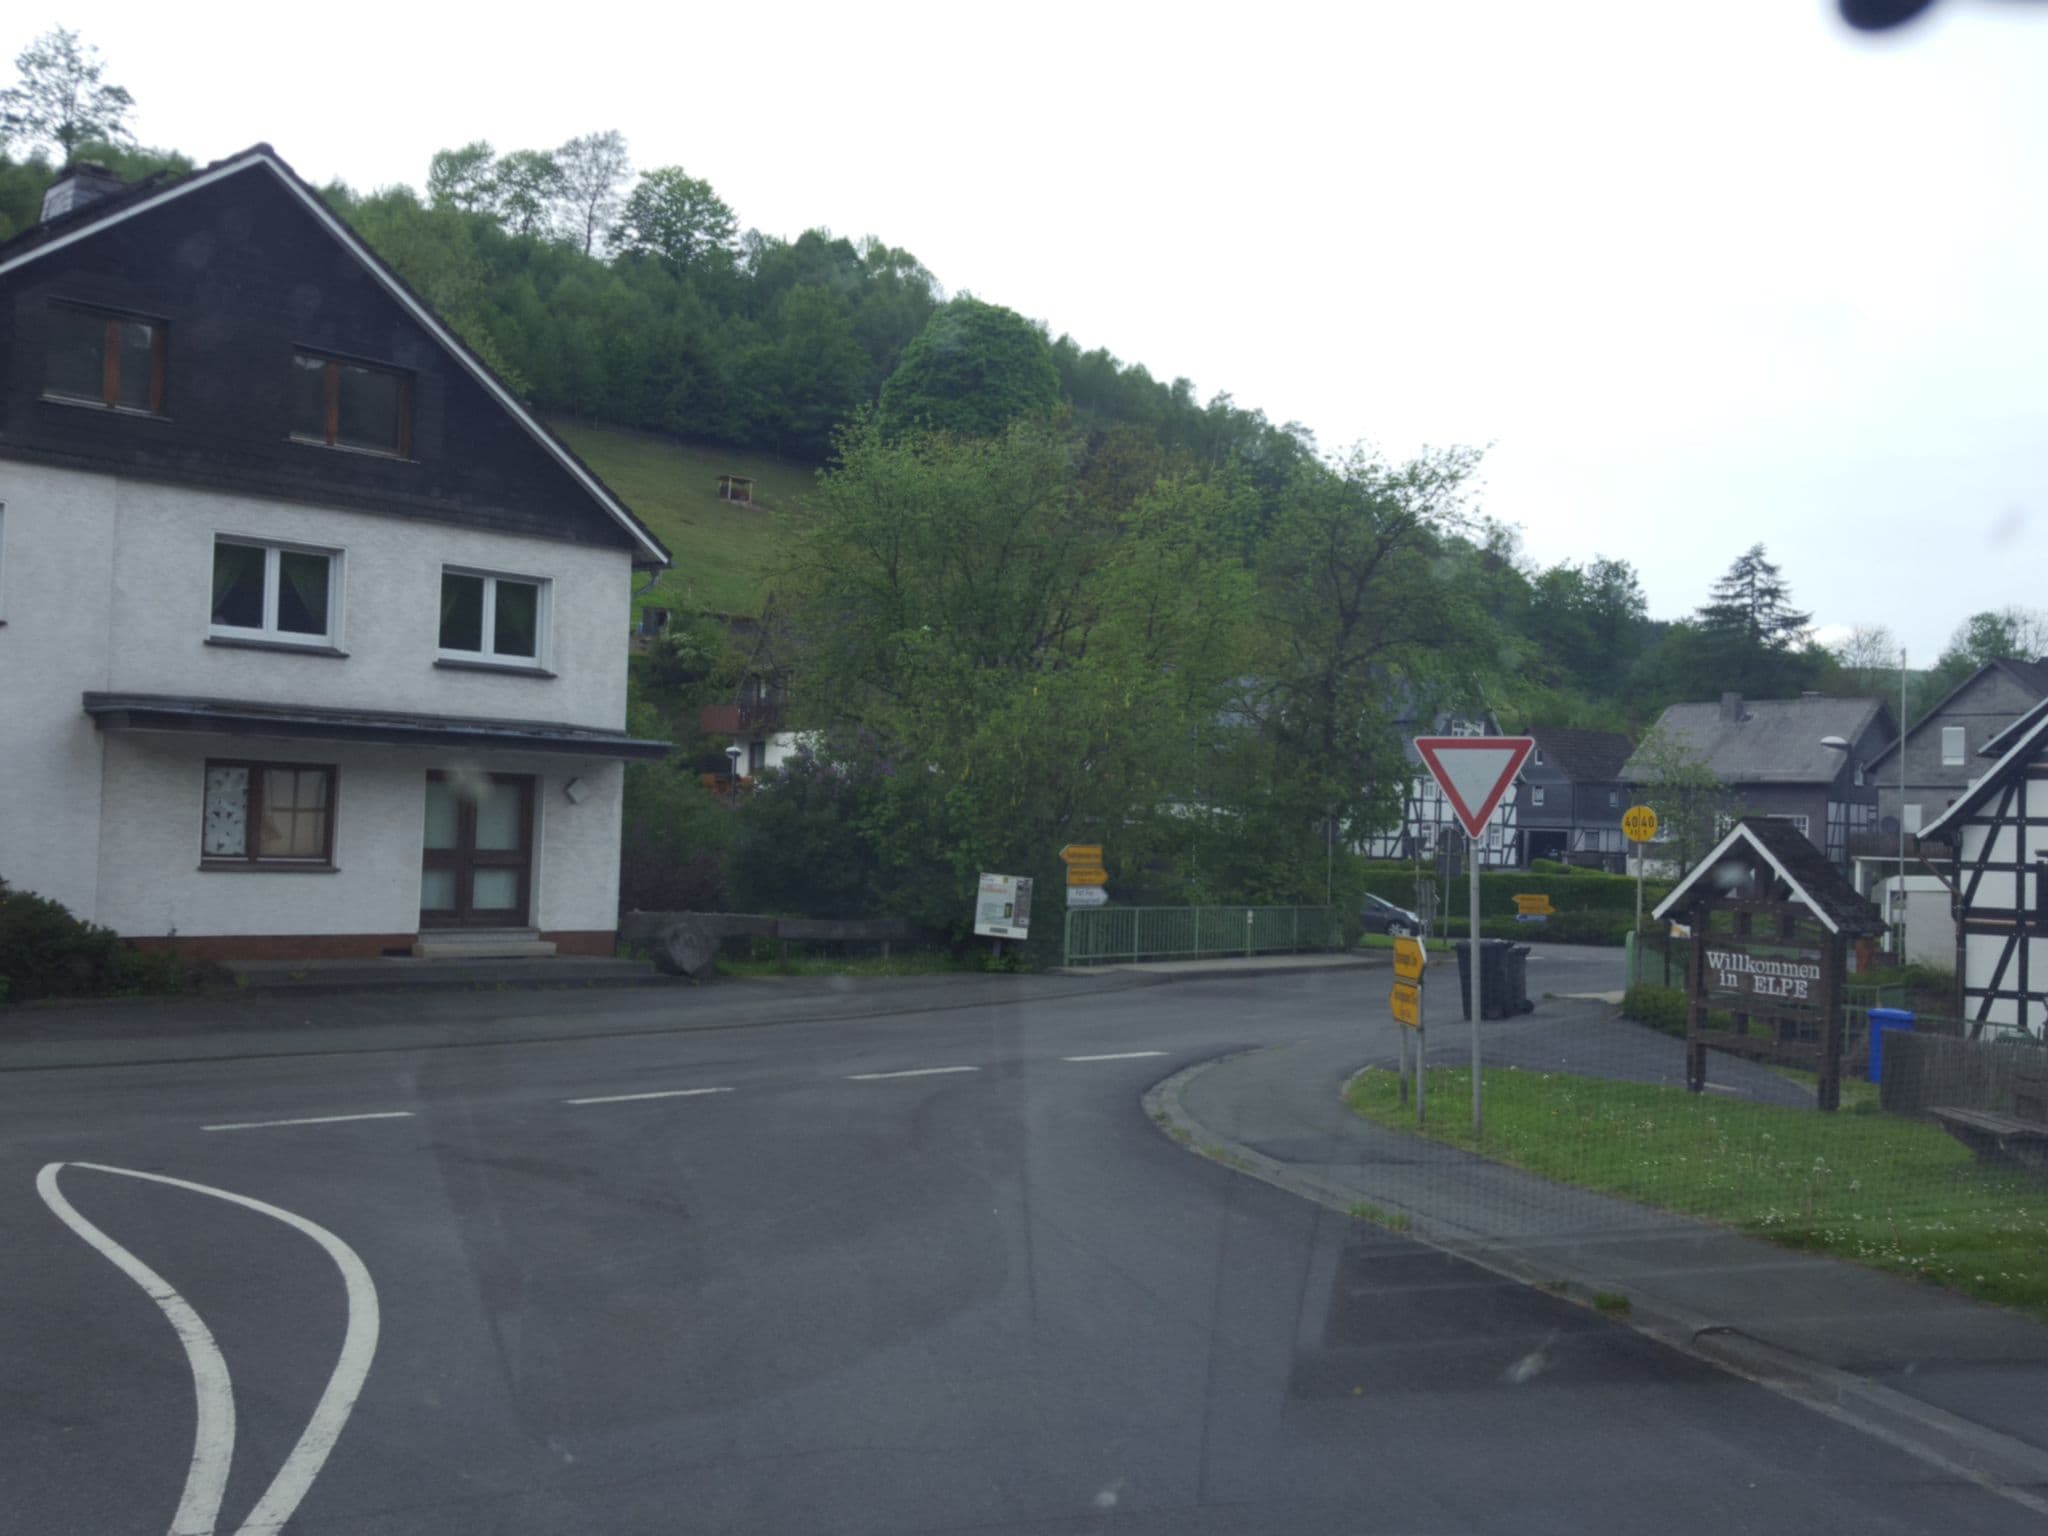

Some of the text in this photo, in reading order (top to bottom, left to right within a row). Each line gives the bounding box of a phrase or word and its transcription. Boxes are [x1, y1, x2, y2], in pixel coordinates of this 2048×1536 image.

[1625, 815, 1655, 829] 40 40
[1706, 951, 1821, 979] Willkommen
[1720, 970, 1808, 998] in ELPE
